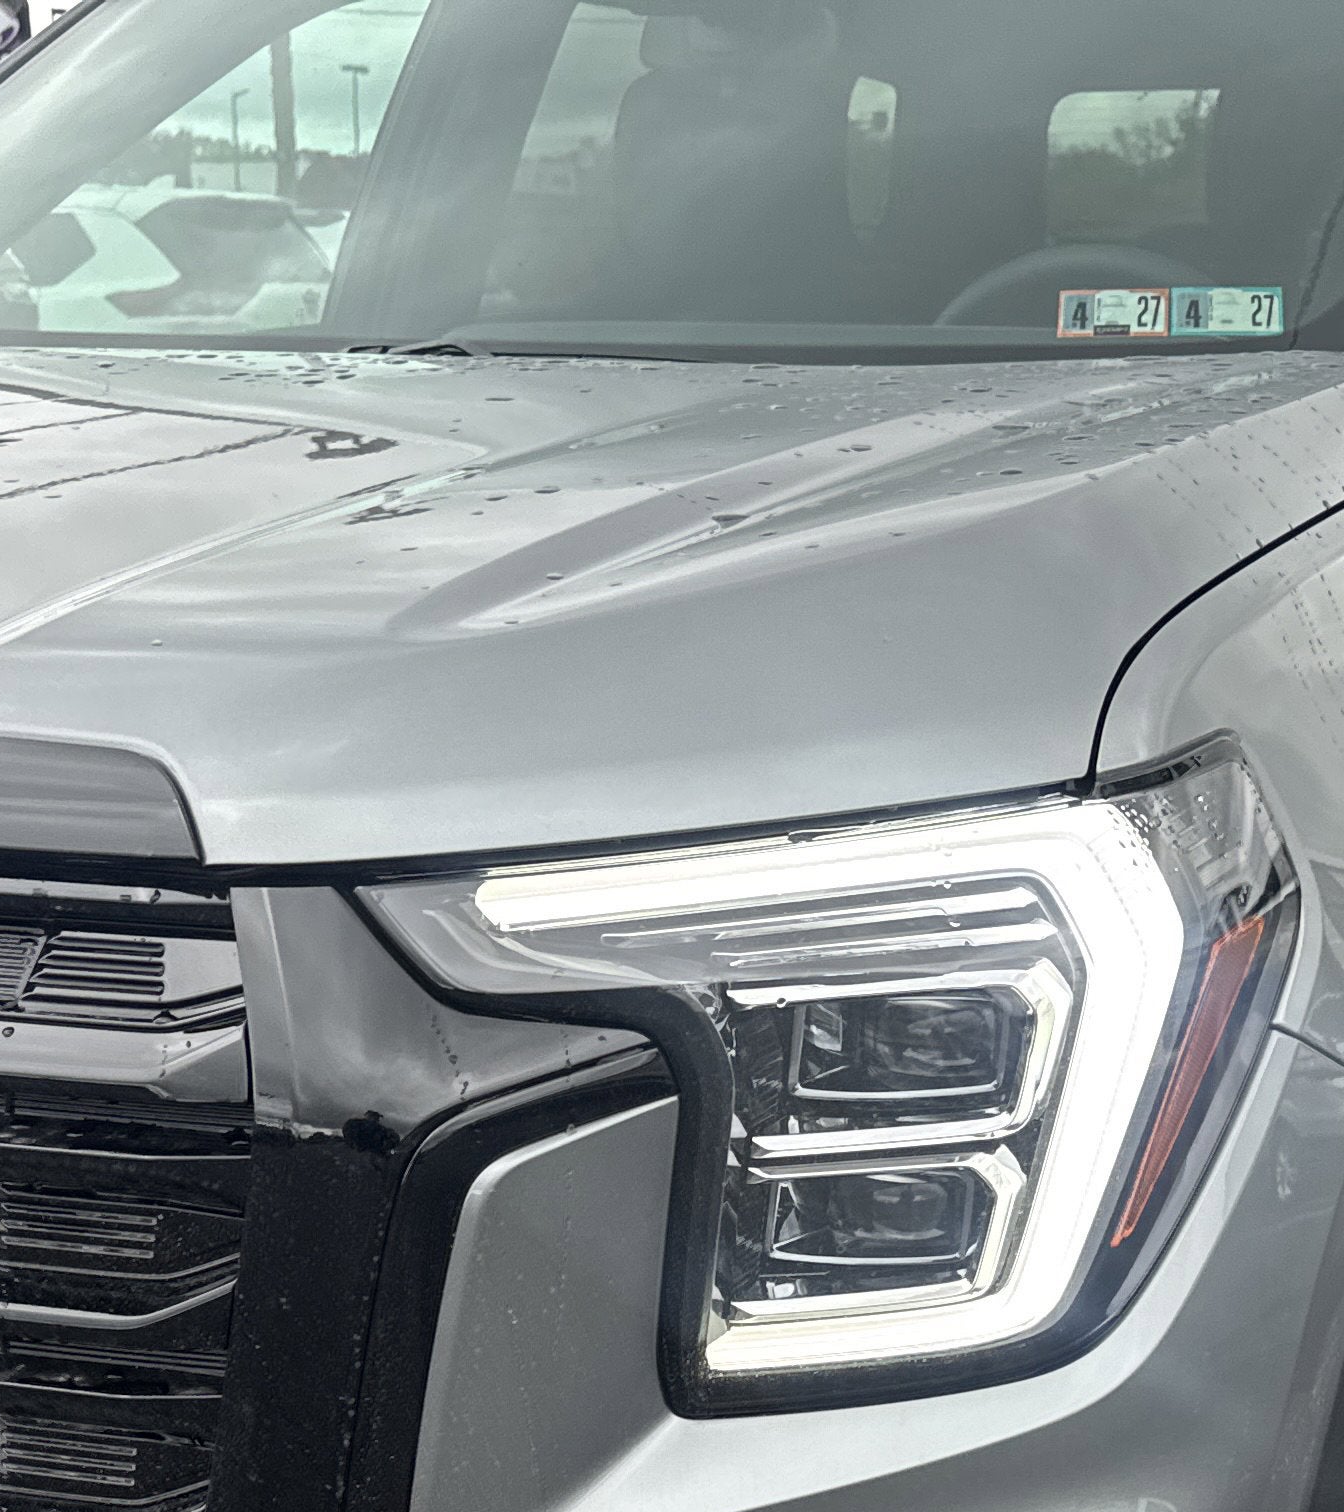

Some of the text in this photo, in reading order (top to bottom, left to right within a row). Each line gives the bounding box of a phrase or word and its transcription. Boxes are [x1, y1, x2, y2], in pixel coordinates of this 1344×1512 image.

[1071, 301, 1089, 330] 4
[1136, 295, 1162, 330] 27
[1185, 299, 1203, 328] 4
[1250, 294, 1275, 329] 27
